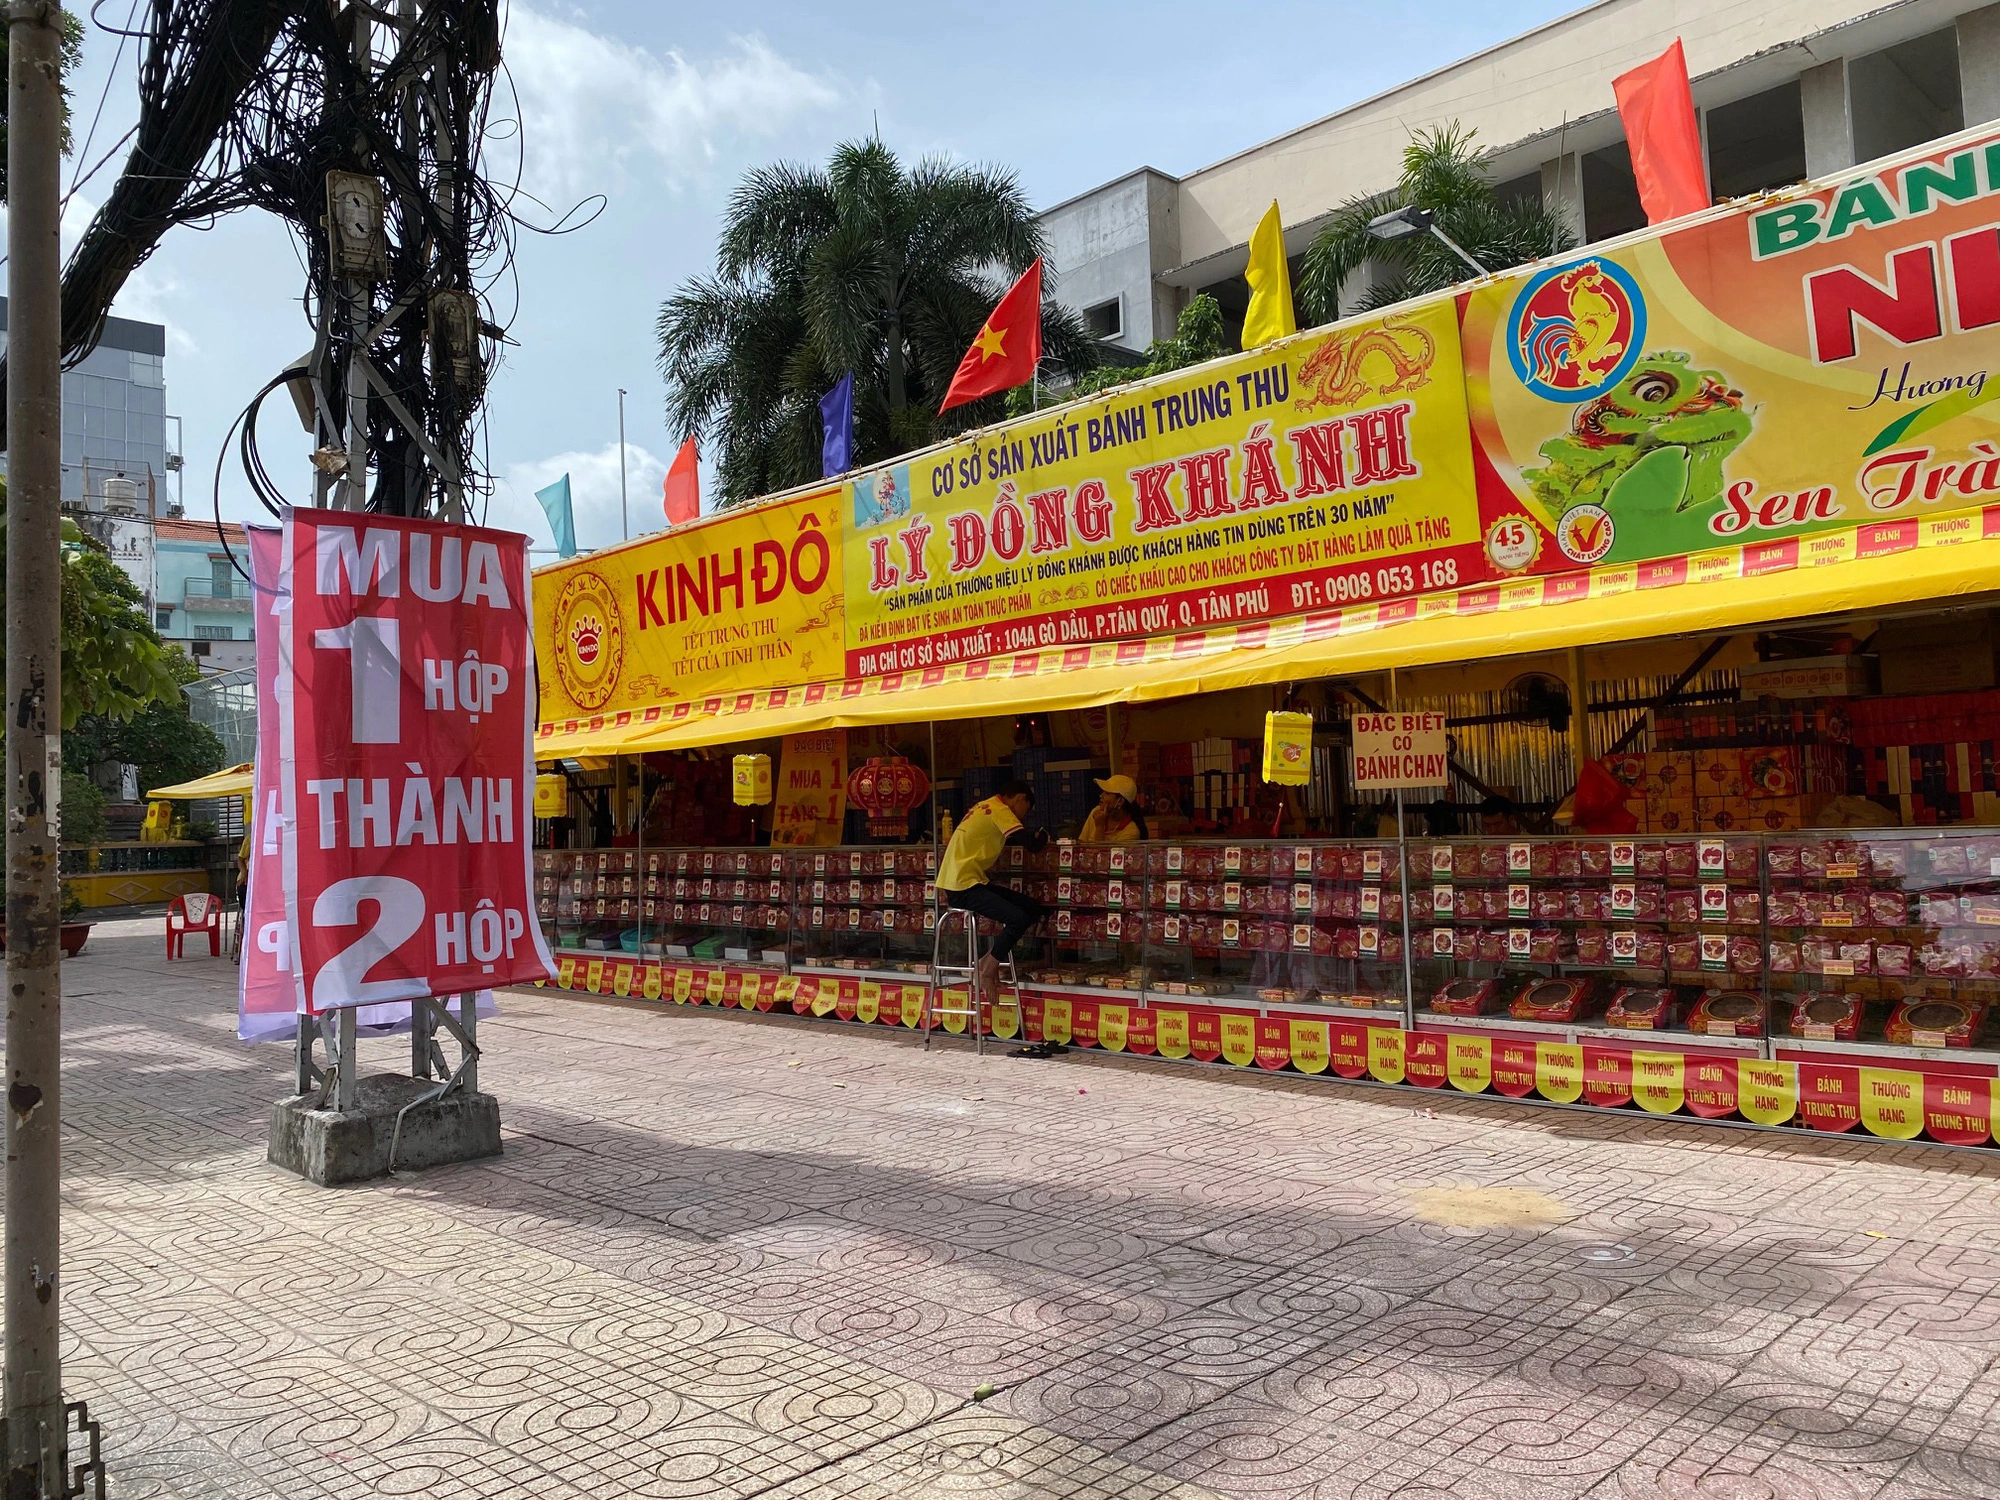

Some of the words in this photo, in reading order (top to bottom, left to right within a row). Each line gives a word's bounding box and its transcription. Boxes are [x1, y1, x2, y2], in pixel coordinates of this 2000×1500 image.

[1755, 143, 2000, 257] BÁN
[1847, 361, 1989, 411] Hương
[932, 455, 954, 497] CƠ
[960, 442, 982, 489] SỞ
[988, 432, 1024, 481] SẢN
[1030, 412, 1080, 469] XUẤT
[1087, 404, 1147, 453] BÁNH
[1152, 380, 1231, 433] TRUNG
[1236, 363, 1290, 411] THU
[870, 513, 932, 591] LÝ
[948, 482, 1114, 573] ĐỒNG
[1130, 403, 1419, 532] KHÁNH
[1712, 481, 1840, 533] Sen
[1862, 444, 2000, 509] Trà
[1494, 523, 1525, 547] 45
[1875, 529, 1900, 543] BÁNH
[1931, 519, 1970, 534] THƯỢNG
[1760, 548, 1783, 561] BÁNH
[1810, 538, 1845, 553] THƯỢNG
[908, 583, 933, 608] PHẨM
[935, 580, 954, 602] CỦA
[956, 575, 993, 597] THƯƠNG
[995, 568, 1018, 592] HIỆU
[1021, 563, 1034, 584] LÝ
[1037, 556, 1066, 579] ĐỒNG
[1068, 549, 1105, 574] KHÁNH
[1108, 544, 1139, 568] ĐƯỢC
[1142, 534, 1183, 560] KHÁCH
[1186, 528, 1221, 553] HÀNG
[1223, 525, 1245, 546] TIN
[1248, 515, 1286, 541] DÙNG
[1288, 505, 1326, 533] TRÊN
[1330, 503, 1349, 525] 30
[1095, 574, 1107, 598] CÓ
[1139, 562, 1165, 590] KHẤU
[1167, 566, 1187, 586] CAO
[1189, 561, 1209, 583] CHO
[1211, 551, 1247, 578] KHÁCH
[1249, 546, 1279, 572] CÔNG
[1280, 545, 1294, 567] TY
[1297, 537, 1320, 568] ĐẶT
[1323, 531, 1356, 559] HÀNG
[1358, 525, 1385, 553] LÀM
[1387, 517, 1413, 551] QUÀ
[1416, 515, 1451, 548] TẶNG
[314, 524, 512, 610] MUA
[1325, 571, 1373, 603] 0908
[1377, 565, 1415, 595] 053
[1420, 558, 1459, 589] 168
[933, 609, 950, 628] SINH
[952, 606, 963, 623] AN
[963, 599, 984, 622] TOÀN
[1008, 584, 1032, 614] PHẨM
[707, 623, 750, 645] TRUNG
[752, 617, 780, 637] THU
[859, 654, 877, 677] ĐỊA
[879, 643, 898, 671] CHỈ
[900, 644, 915, 669] CƠ
[918, 637, 933, 665] SỞ
[936, 633, 960, 662] SẢN
[1004, 625, 1036, 650] 104A
[1039, 616, 1057, 645] GÒ
[1198, 590, 1231, 621] TÂN
[1235, 582, 1270, 617] PHÚ
[697, 650, 720, 672] CỦA
[757, 637, 793, 660] THÂN
[314, 616, 401, 744] 1
[423, 649, 509, 724] HỘP
[1357, 712, 1396, 736] ĐẶC
[1402, 711, 1444, 734] BIỆT
[1392, 731, 1412, 751] CÓ
[790, 769, 822, 789] MUA
[830, 757, 843, 790] 1
[1356, 748, 1400, 781] BÁNH
[1402, 754, 1445, 779] CHAY
[306, 761, 514, 849] THÀNH
[826, 794, 839, 826] 1
[311, 875, 433, 1010] 2
[434, 898, 525, 974] HỘP
[1340, 1033, 1358, 1047] BÁNH
[1417, 1040, 1436, 1056] BÁNH
[1333, 1053, 1352, 1066] TRUNG
[1353, 1055, 1366, 1067] THU
[1456, 1045, 1483, 1060] THƯỢNG
[1504, 1048, 1524, 1064] BÁNH
[1545, 1053, 1574, 1069] THƯỢNG
[1407, 1062, 1430, 1076] TRUNG
[1431, 1064, 1445, 1077] THU
[1460, 1066, 1479, 1081] HẠNG
[1597, 1057, 1619, 1073] BÁNH
[1642, 1062, 1675, 1078] THƯỢNG
[1699, 1065, 1723, 1082] BÁNH
[1495, 1070, 1517, 1084] TRUNG
[1518, 1073, 1533, 1086] THU
[1549, 1075, 1569, 1090] HẠNG
[1749, 1070, 1784, 1089] THƯỢNG
[1817, 1075, 1843, 1094] BÁNH
[1586, 1080, 1612, 1094] TRUNG
[1613, 1082, 1629, 1096] THU
[1647, 1085, 1670, 1100] HẠNG
[1872, 1080, 1911, 1100] THƯỢNG
[1943, 1086, 1972, 1105] BÁNH
[1688, 1089, 1715, 1105] TRUNG
[1716, 1092, 1734, 1107] THU
[1755, 1095, 1779, 1112] HẠNG
[1805, 1101, 1836, 1118] TRUNG
[1836, 1104, 1856, 1120] THU
[1879, 1108, 1906, 1125] HẠNG
[1929, 1113, 1963, 1130] TRUNG
[1965, 1116, 1986, 1133] THU
